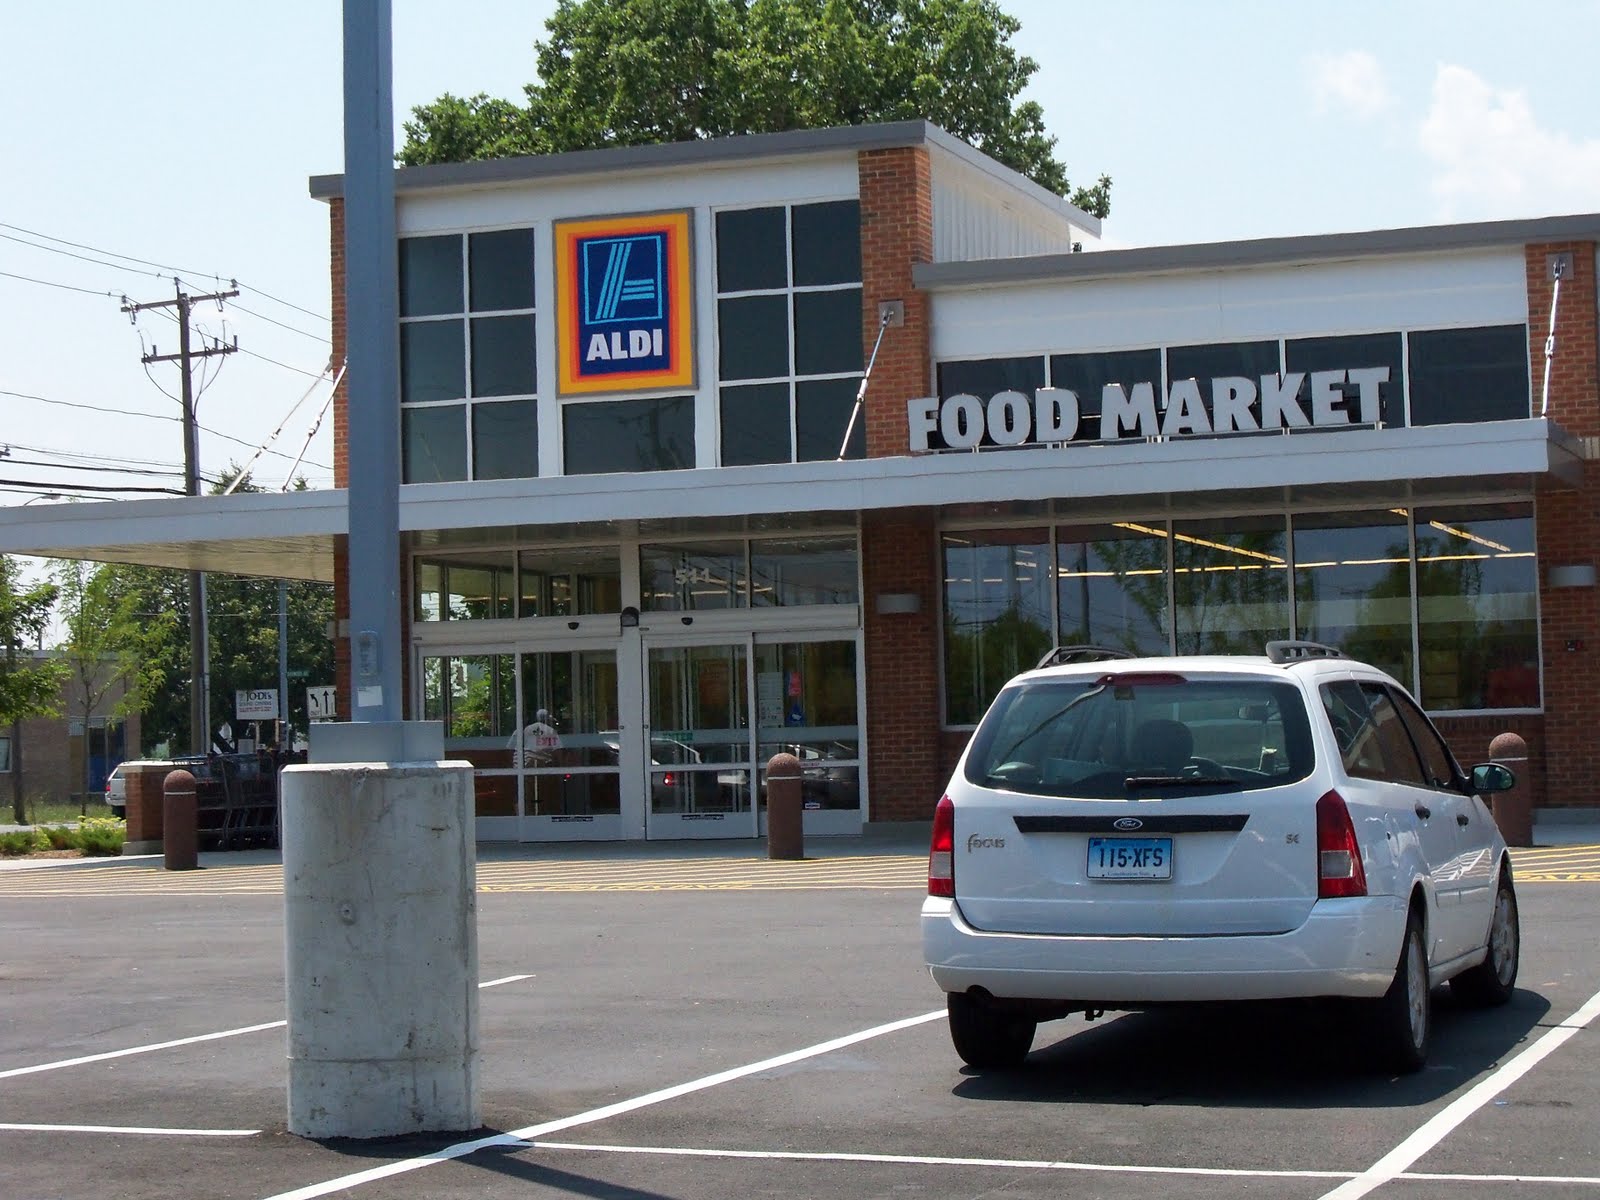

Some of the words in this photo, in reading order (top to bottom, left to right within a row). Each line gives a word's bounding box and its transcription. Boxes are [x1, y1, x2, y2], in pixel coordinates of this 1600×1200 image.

[586, 329, 663, 361] ALDI
[908, 387, 1079, 451] FOOD
[1100, 366, 1391, 438] MARKET
[536, 737, 558, 746] EXIT
